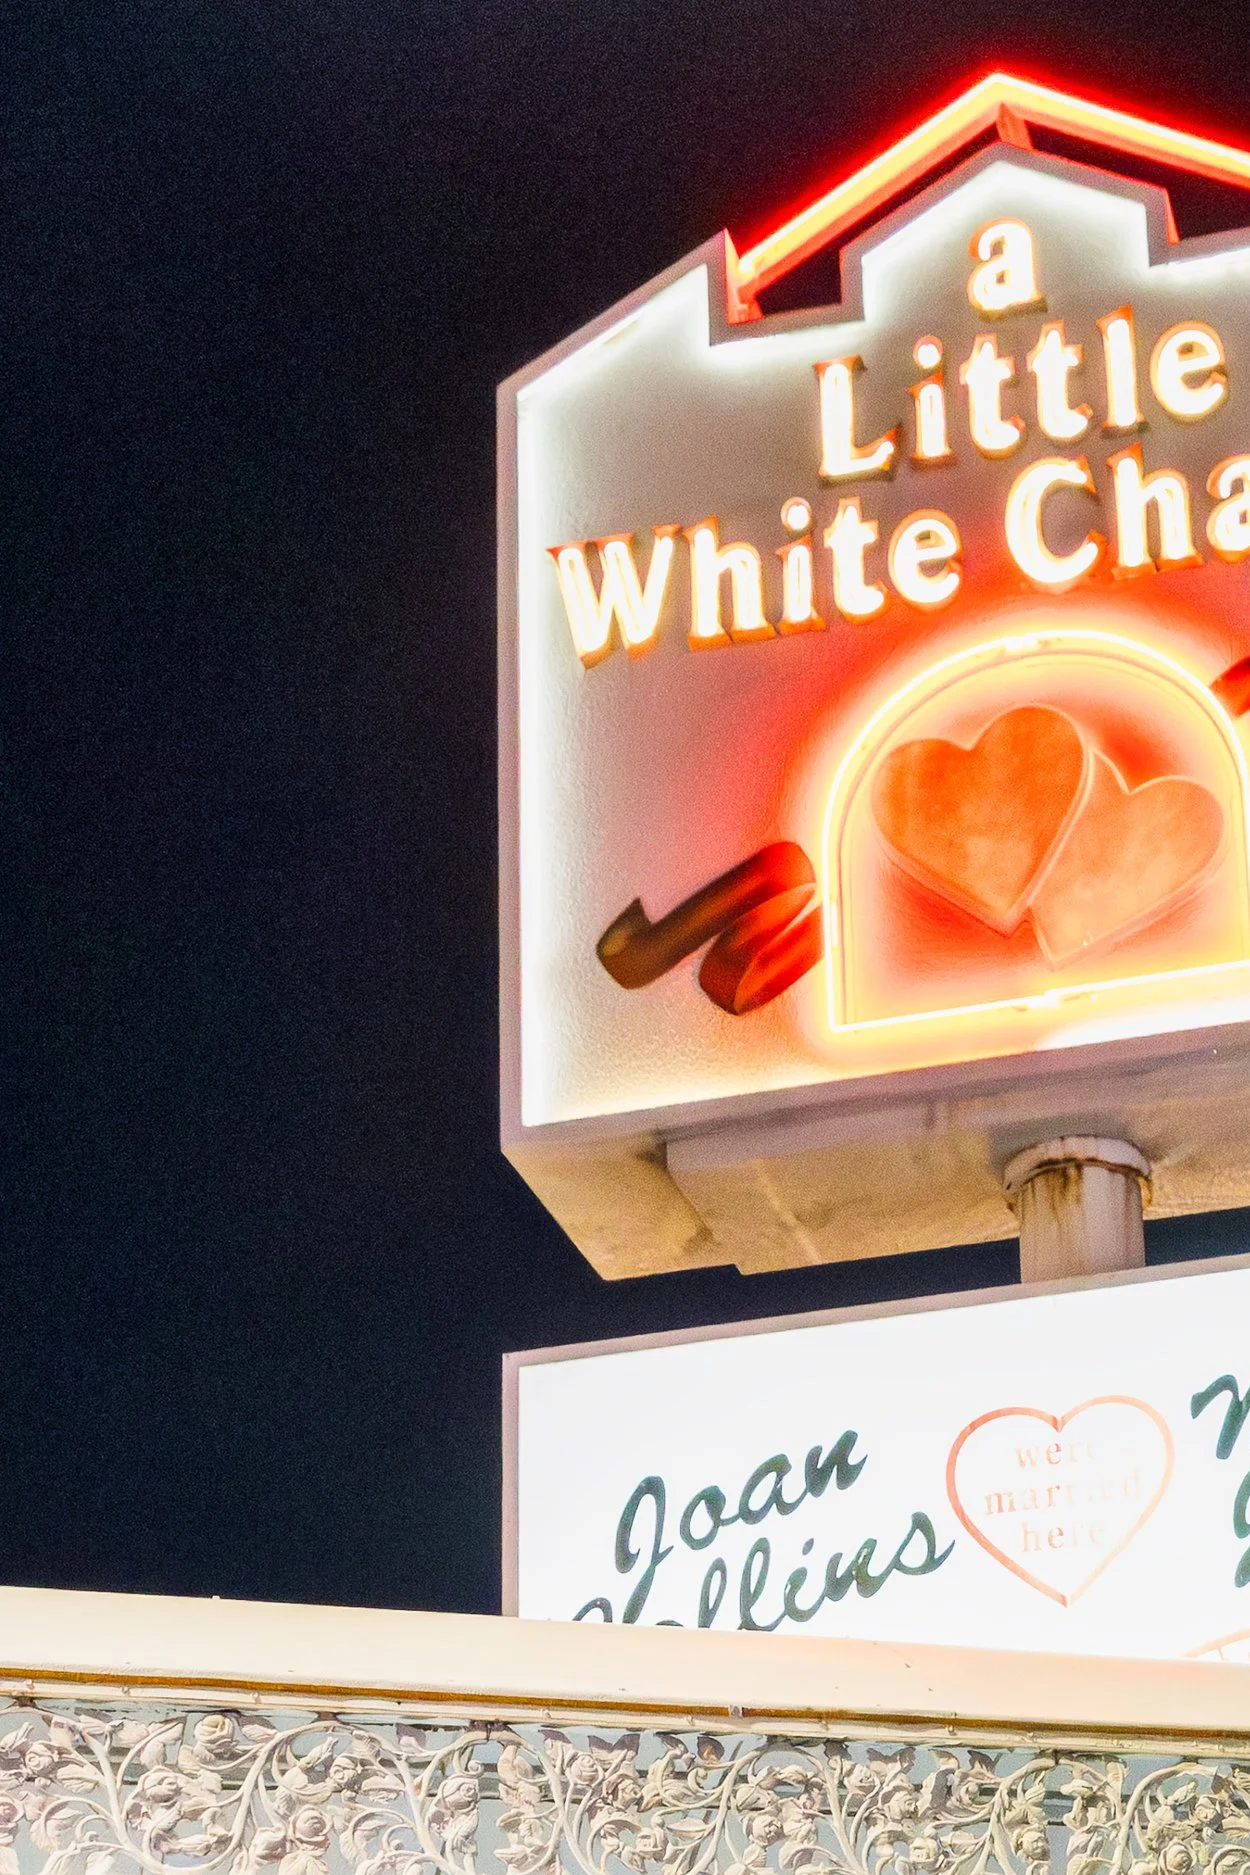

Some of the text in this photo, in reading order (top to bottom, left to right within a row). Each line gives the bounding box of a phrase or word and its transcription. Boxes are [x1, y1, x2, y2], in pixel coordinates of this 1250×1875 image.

[967, 218, 1042, 315] a
[814, 305, 1230, 481] Little
[548, 496, 963, 668] White
[615, 1429, 868, 1625] Joan
[983, 1466, 1144, 1516] marrd
[572, 1511, 955, 1632] llins
